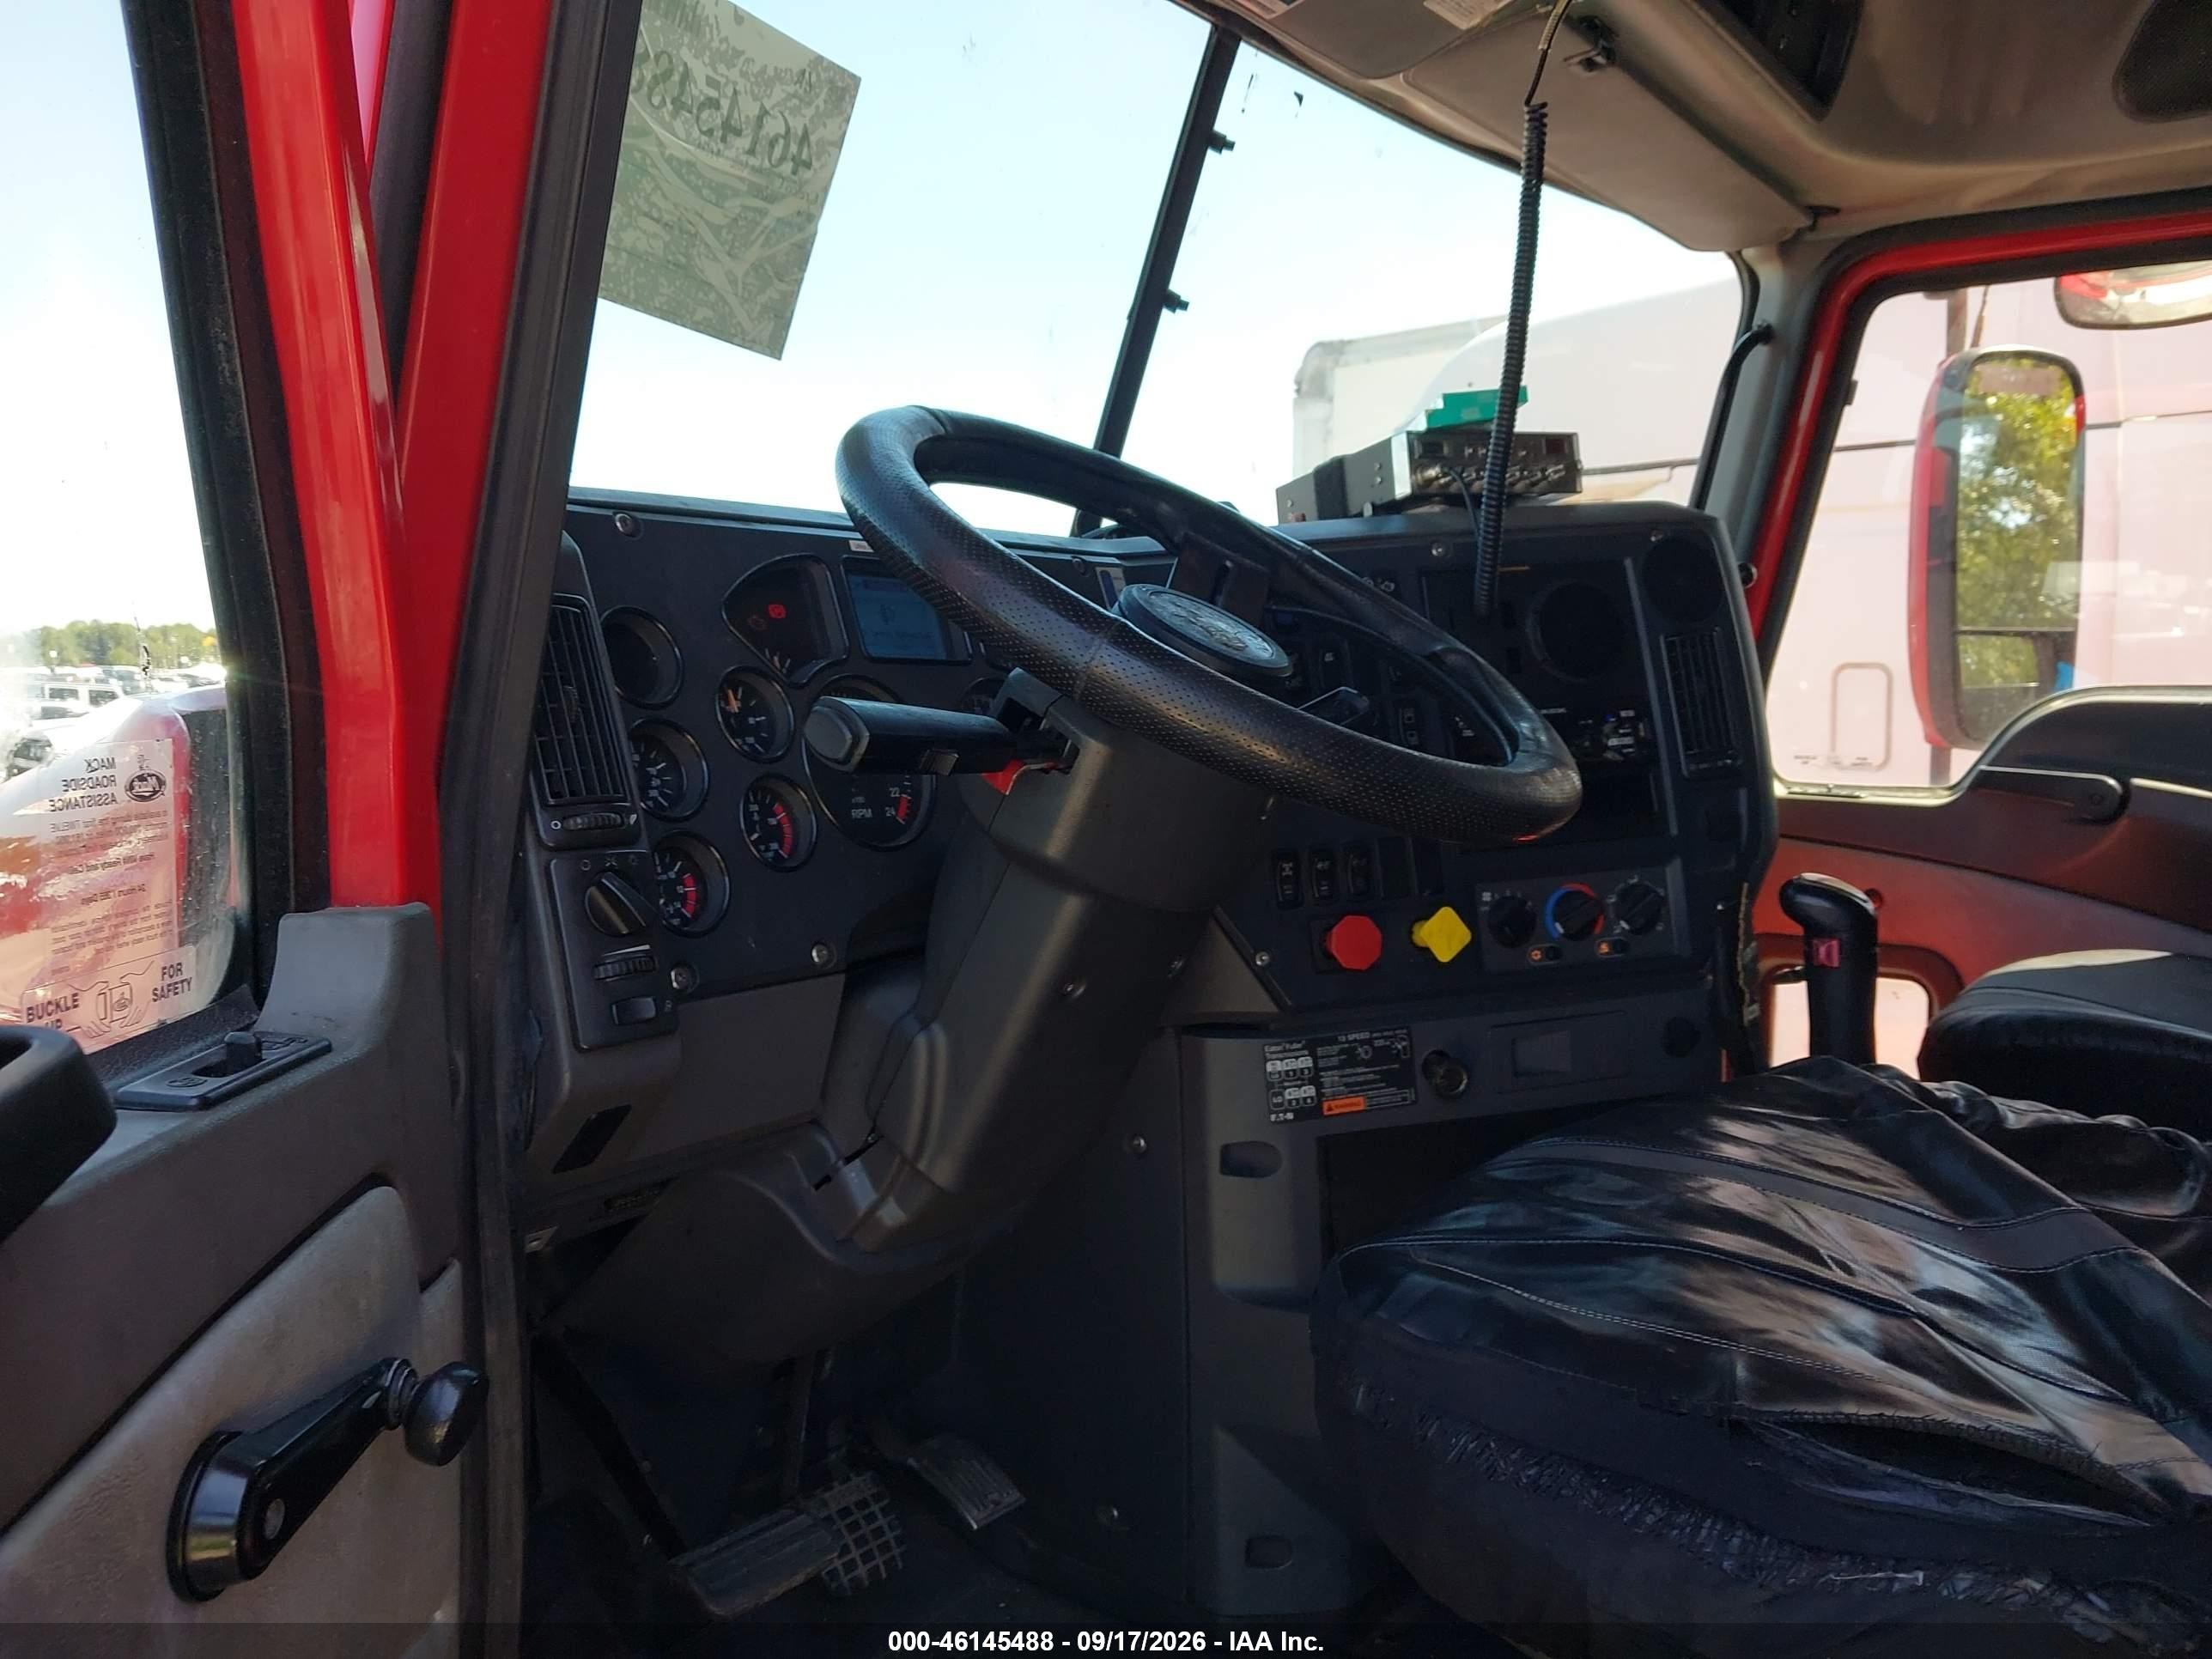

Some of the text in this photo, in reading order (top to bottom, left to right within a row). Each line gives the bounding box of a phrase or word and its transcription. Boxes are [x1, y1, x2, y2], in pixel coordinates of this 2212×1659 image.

[851, 808, 873, 818] RPM
[161, 962, 184, 981] FOR
[151, 977, 193, 1003] SAFETY
[27, 993, 80, 1024] BUCKLE
